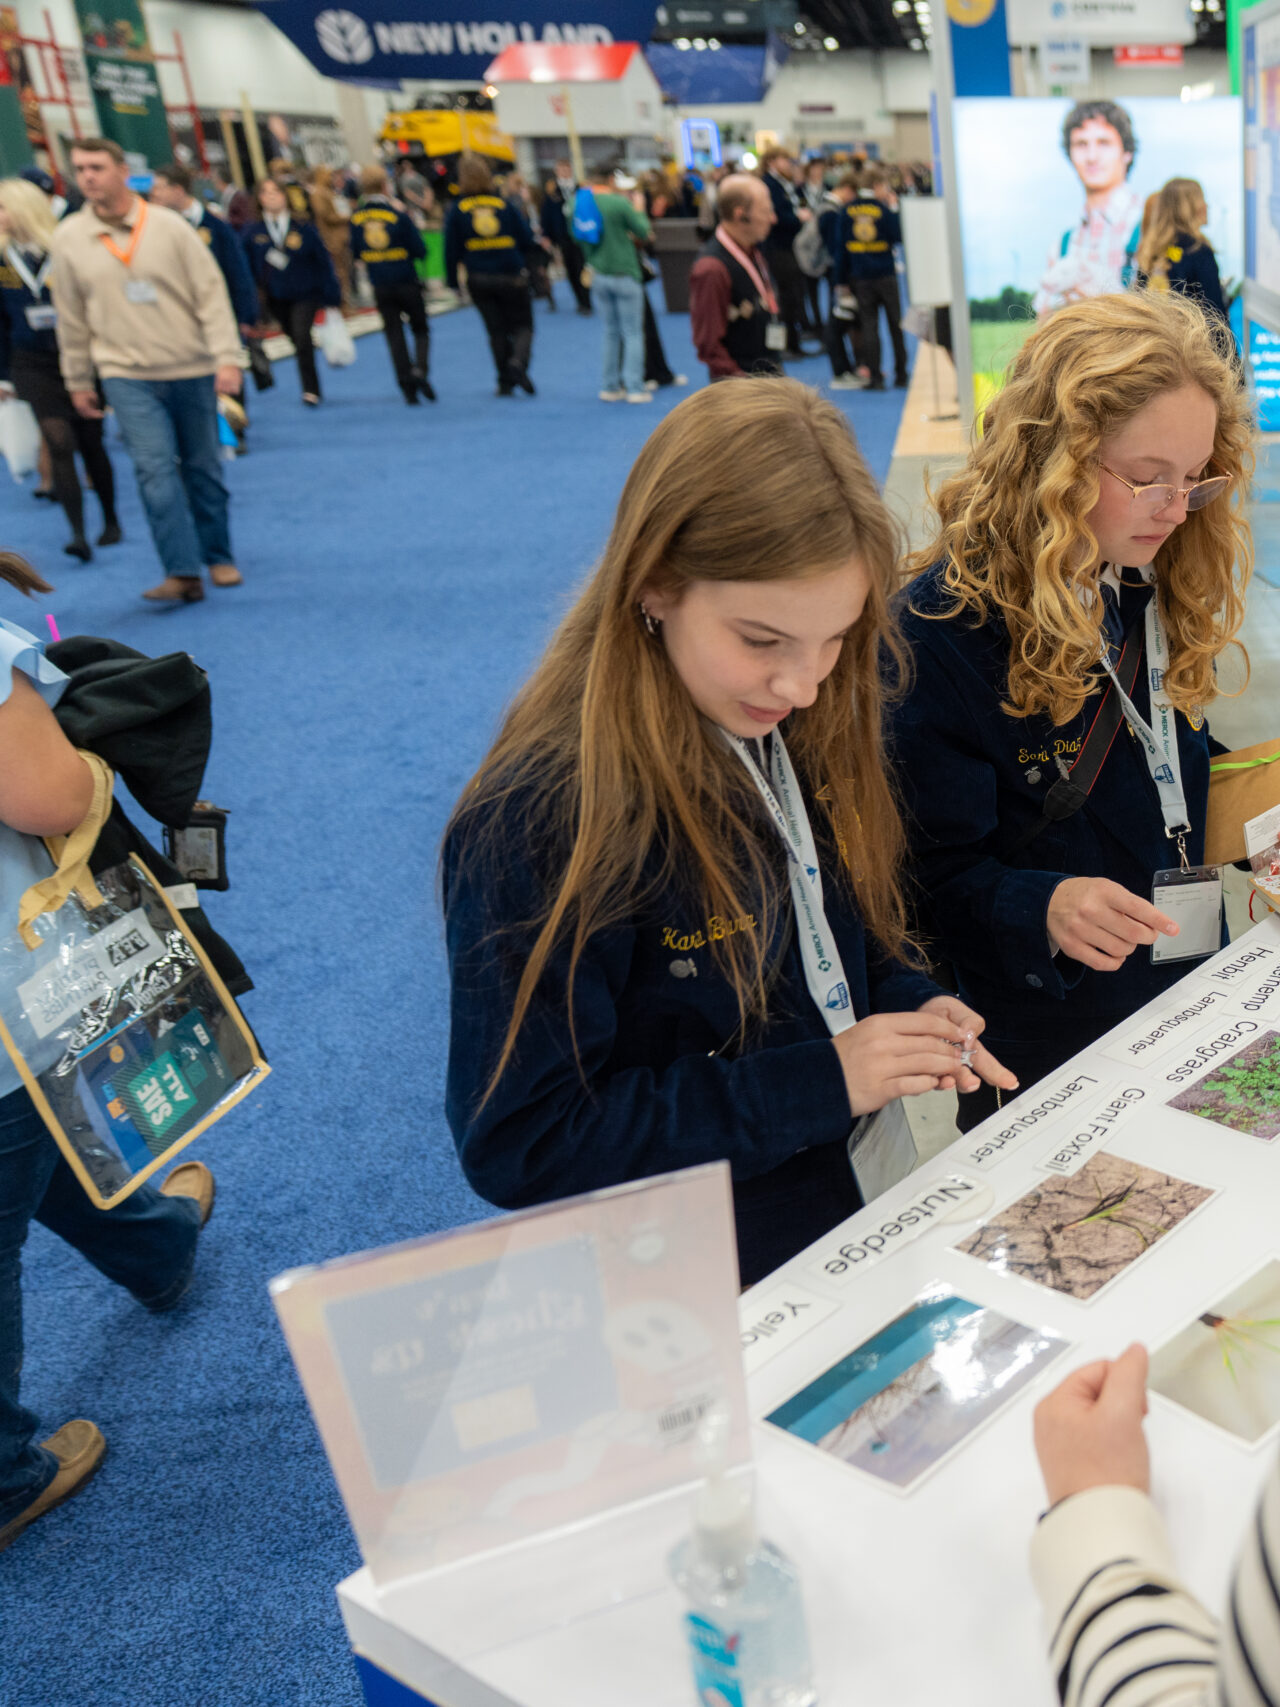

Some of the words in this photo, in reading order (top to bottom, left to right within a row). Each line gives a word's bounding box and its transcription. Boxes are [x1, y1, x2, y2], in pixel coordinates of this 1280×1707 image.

[373, 21, 452, 54] NEW
[454, 21, 614, 54] HOLLAND
[1160, 715, 1170, 738] MERCK
[782, 787, 794, 821] Animal
[803, 905, 817, 931] Animal
[810, 932, 826, 960] MERCK
[1211, 947, 1274, 981] Henbit
[1128, 991, 1229, 1056] Lambsquarter
[1166, 1020, 1259, 1084] Crabgrass
[160, 1063, 191, 1102] ALL
[969, 1075, 1100, 1164] Lambsquarter
[1094, 1087, 1146, 1124] Giant
[1044, 1122, 1109, 1173] Foxtail
[823, 1177, 975, 1276] Nutsedge
[740, 1300, 812, 1348] Yello
